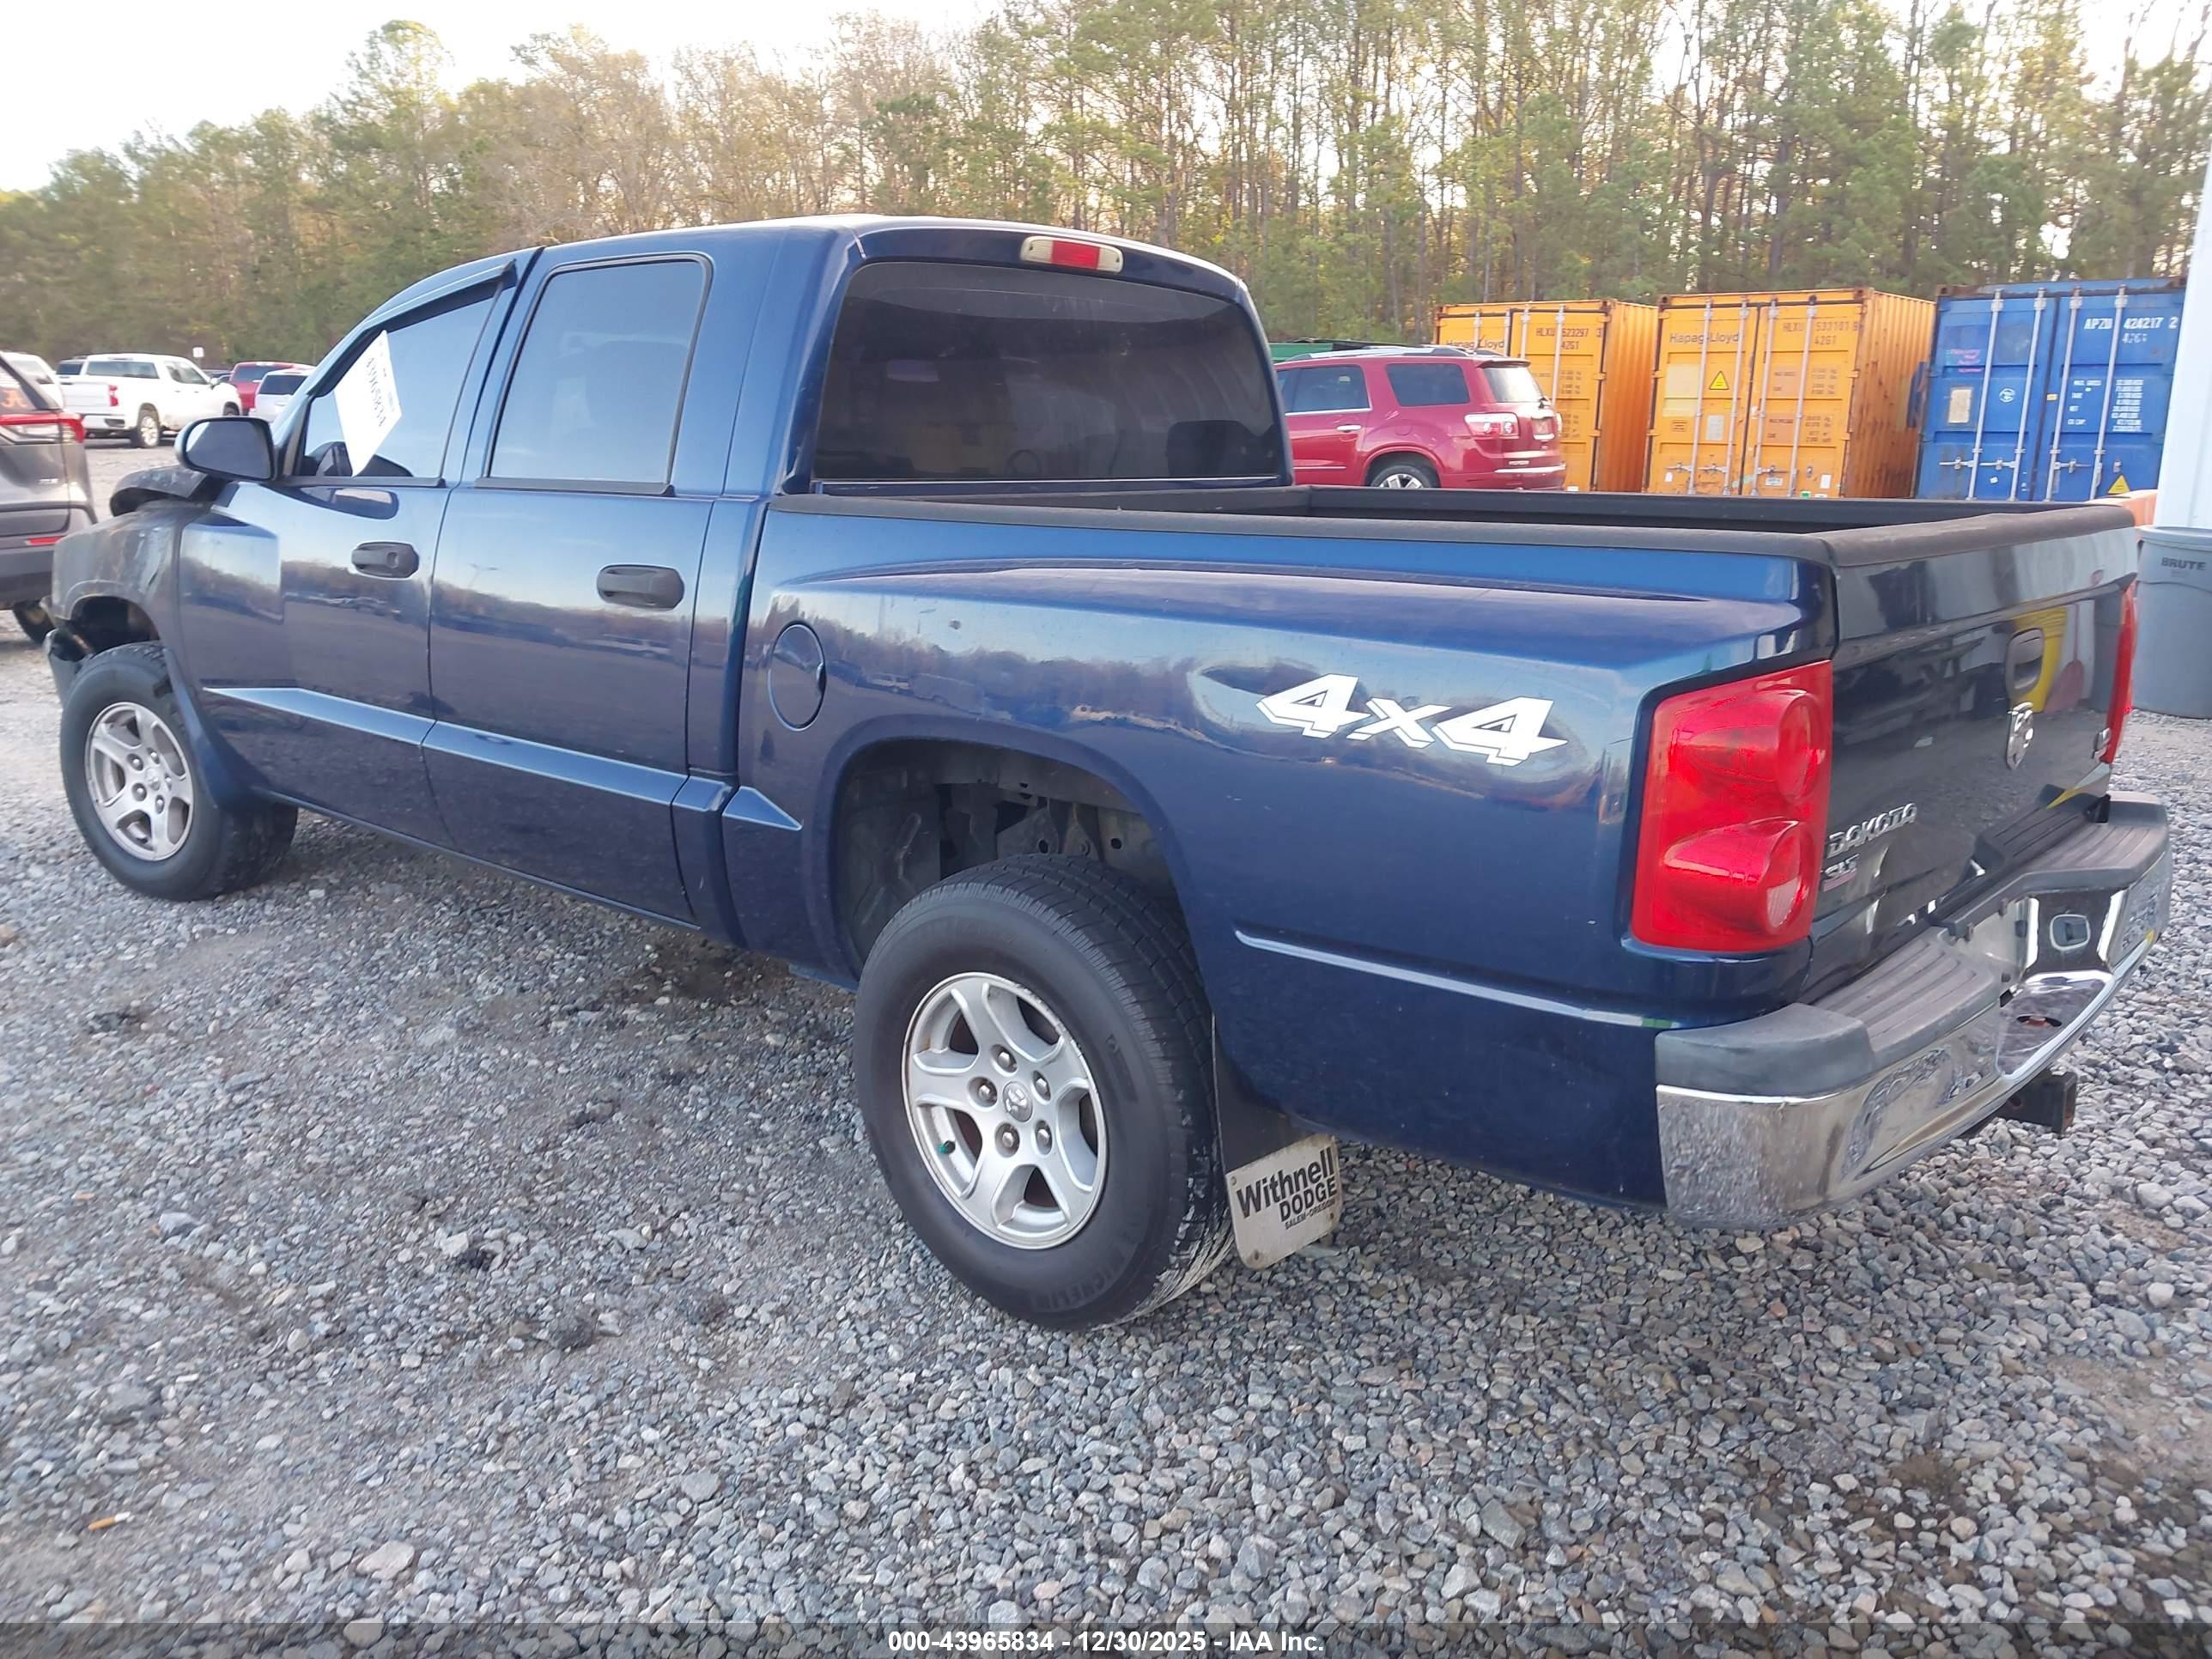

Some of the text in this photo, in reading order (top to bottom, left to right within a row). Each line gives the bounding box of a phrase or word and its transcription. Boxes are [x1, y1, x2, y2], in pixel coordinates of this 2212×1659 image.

[2124, 317, 2165, 331] 424217
[2168, 316, 2179, 330] 2
[2160, 556, 2206, 571] BRUTE
[1255, 673, 1570, 767] 4x4
[1827, 802, 1917, 855] DAKOTA
[1236, 1146, 1335, 1219] Withnell
[1279, 1177, 1338, 1223] DODGE
